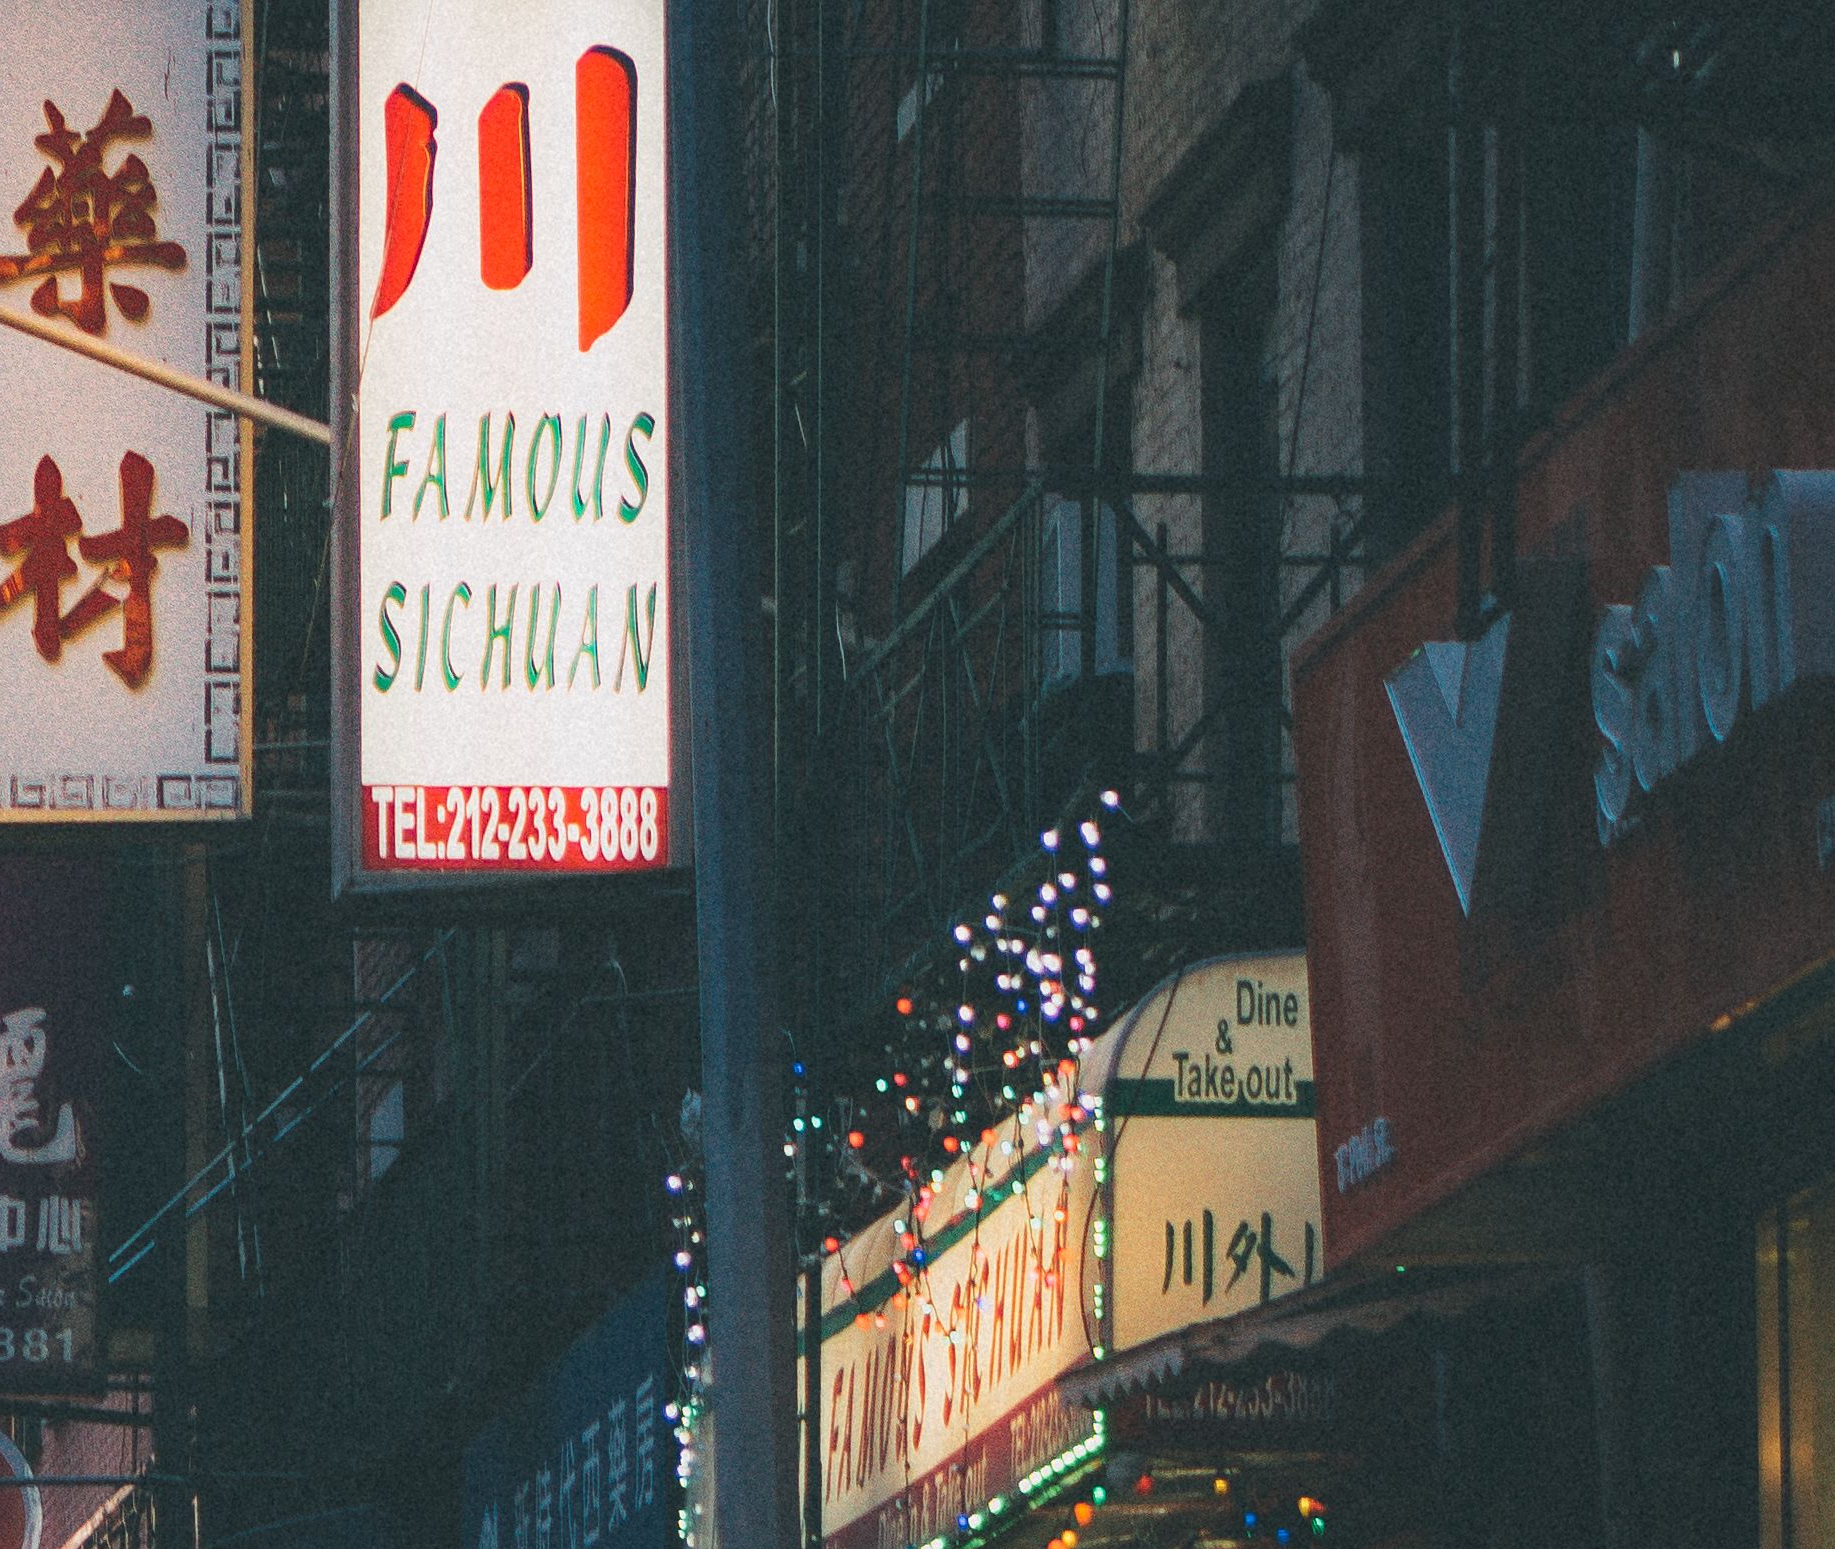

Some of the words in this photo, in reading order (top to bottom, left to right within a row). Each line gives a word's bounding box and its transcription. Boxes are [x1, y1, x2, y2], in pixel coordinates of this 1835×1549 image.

[369, 44, 638, 352] 川
[380, 410, 657, 524] FAMOUS
[372, 580, 658, 694] SICHUAN
[372, 786, 658, 862] TEL:212-233-3888
[1215, 1018, 1233, 1054] &
[1236, 980, 1299, 1027] Dine
[1163, 1208, 1314, 1308] 川外
